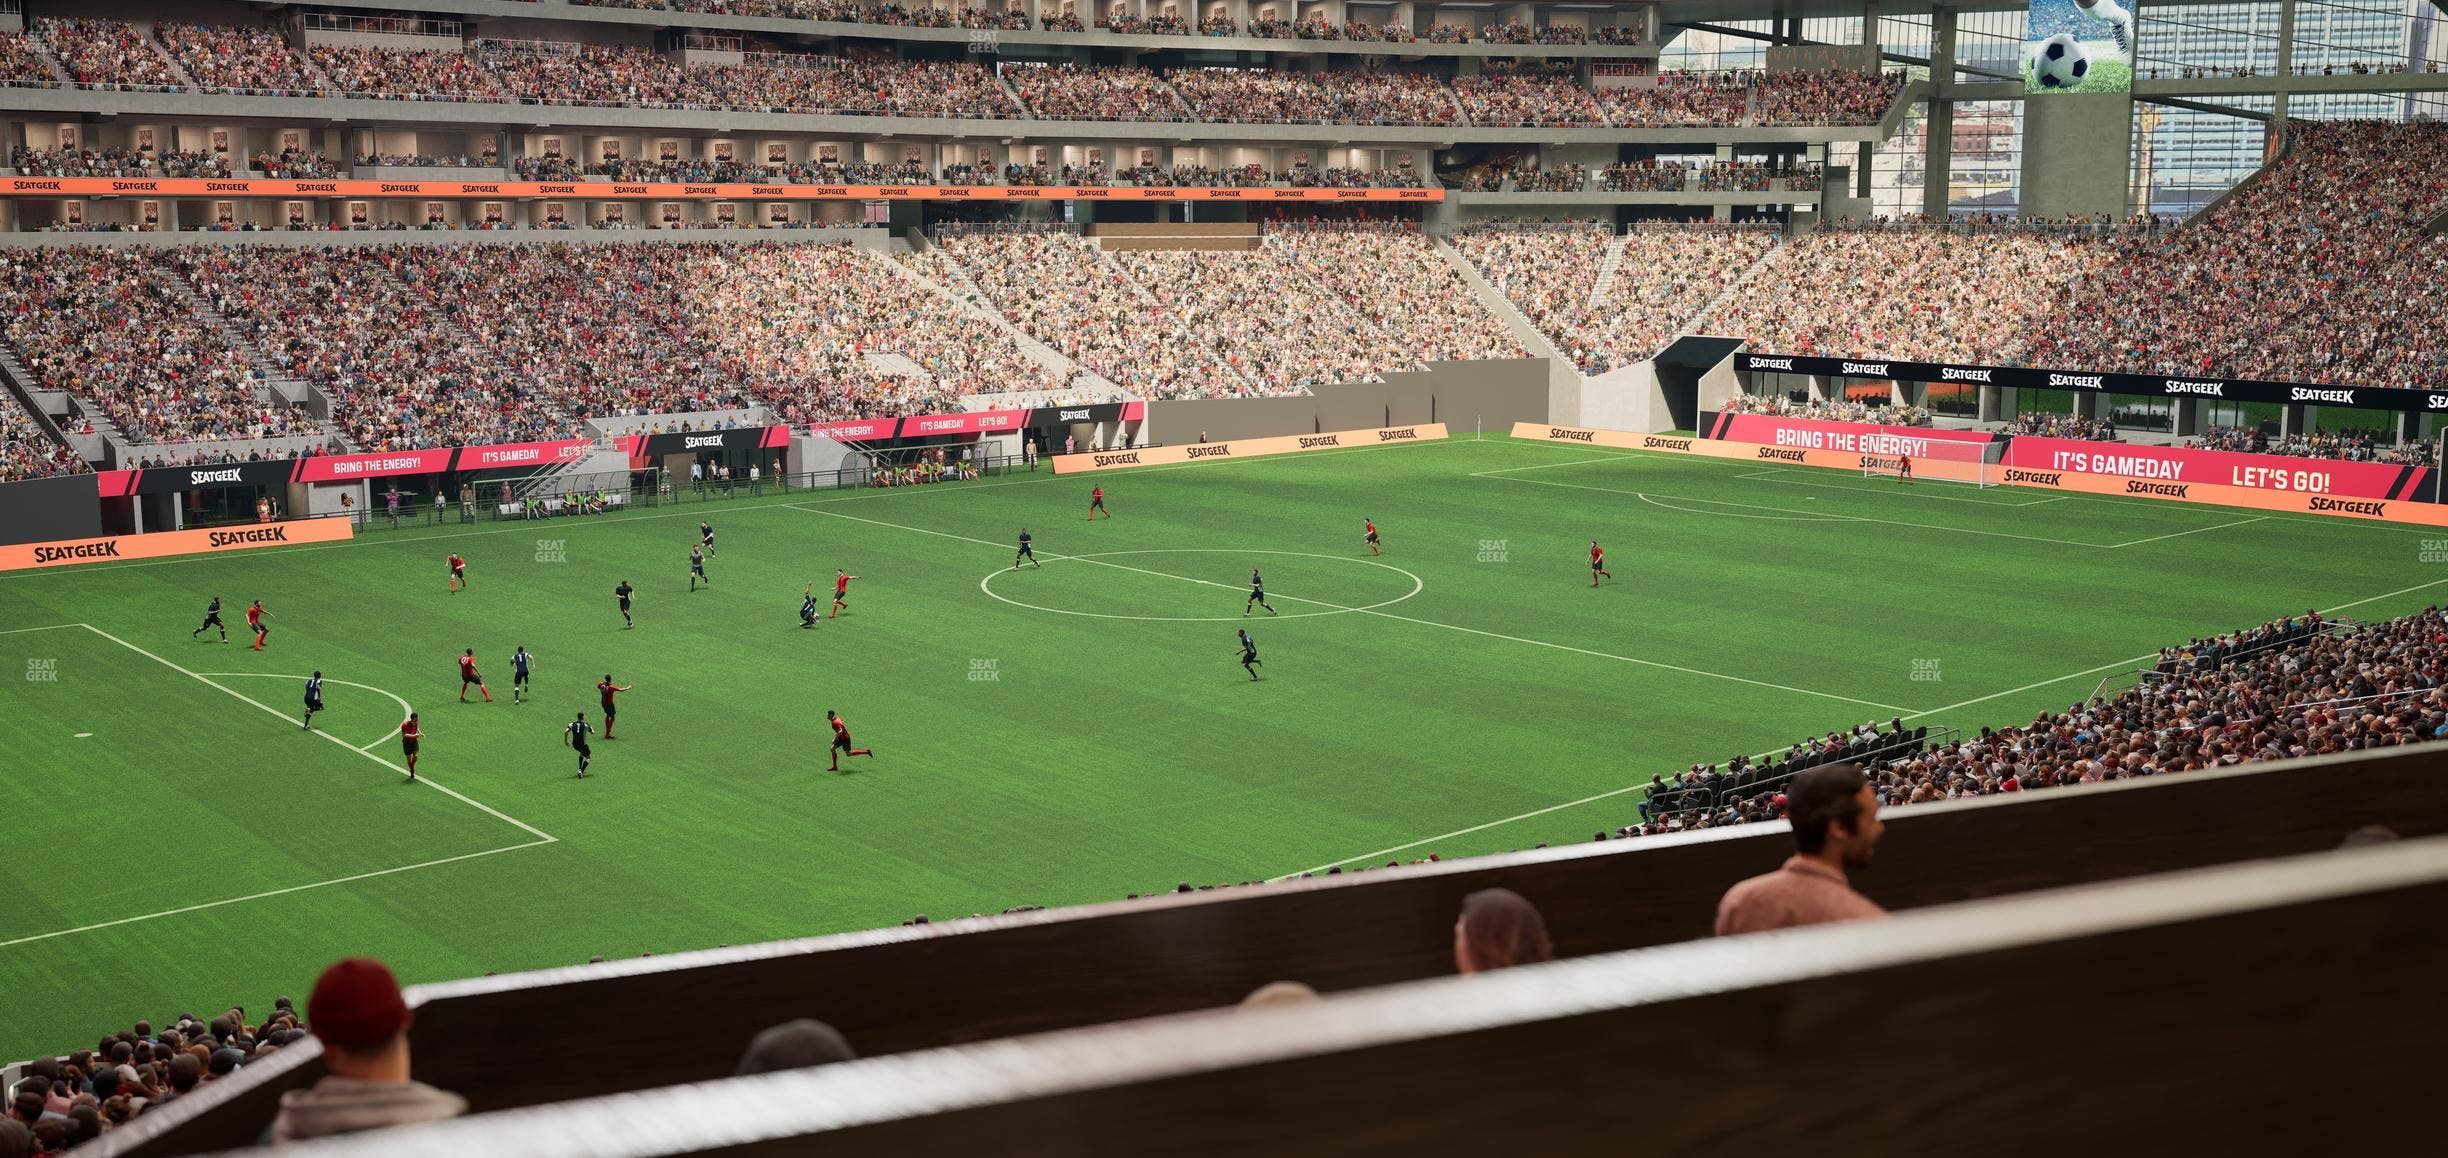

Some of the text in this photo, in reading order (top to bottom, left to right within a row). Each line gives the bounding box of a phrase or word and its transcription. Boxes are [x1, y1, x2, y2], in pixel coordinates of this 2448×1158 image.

[13, 181, 61, 191] SEATGEEK
[112, 182, 158, 191] SEATGEEK
[206, 183, 249, 192] SEATGEEK
[295, 184, 337, 192] SEATGEEK
[381, 184, 420, 193] SEATGEEK
[462, 185, 499, 193] SEATGEEK
[539, 186, 575, 194] SEATGEEK
[613, 186, 648, 194] SEATGEEK
[684, 186, 717, 195] SEATGEEK
[752, 187, 784, 195] SEATGEEK
[817, 187, 847, 195] SEATGEEK
[879, 188, 908, 196] SEATGEEK
[939, 189, 970, 197] SEATGEEK
[1007, 189, 1040, 197] SEATGEEK
[1076, 189, 1108, 197] SEATGEEK
[1144, 189, 1175, 197] SEATGEEK
[1210, 190, 1241, 198] SEATGEEK
[1274, 190, 1305, 198] SEATGEEK
[1337, 190, 1367, 198] SEATGEEK
[1749, 356, 1793, 371] SEATGEEK
[1842, 361, 1889, 377] SEATGEEK
[1941, 367, 1992, 383] SEATGEEK
[2049, 373, 2103, 389] SEATGEEK
[2165, 379, 2224, 396] SEATGEEK
[2291, 386, 2355, 403] SEATGEEK
[1059, 408, 1091, 422] SEATGEEK
[831, 428, 844, 437] THE
[845, 425, 874, 436] ENERGY!
[920, 421, 934, 431] IT'S
[934, 419, 964, 430] GAMEDAY
[978, 417, 996, 427] LET'S
[684, 434, 724, 449] SEATGEEK
[1299, 434, 1339, 449] SEATGEEK
[1378, 428, 1417, 442] SEATGEEK
[1549, 427, 1595, 442] SEATGEEK
[1643, 436, 1691, 452] SEATGEEK
[1776, 428, 1928, 458] BRING THE ENERGY!
[482, 451, 499, 463] IT'S
[500, 449, 540, 462] GAMEDAY
[1187, 444, 1231, 459] SEATGEEK
[1757, 446, 1807, 464] SEATGEEK
[333, 456, 421, 474] BRING THE ENERGY!
[1094, 452, 1141, 468] SEATGEEK
[1859, 456, 1901, 470] SEATGEE
[191, 467, 242, 485] SEATGEEK
[2003, 469, 2061, 487] SEATGEEK
[2053, 451, 2330, 493] IT'S GAMEDAY LET'S GO!
[2126, 480, 2189, 499] SEATGEEK
[2308, 496, 2386, 517] SEATGEEK
[209, 526, 287, 548] SEATGEEK
[34, 540, 120, 564] SEATGEEK
